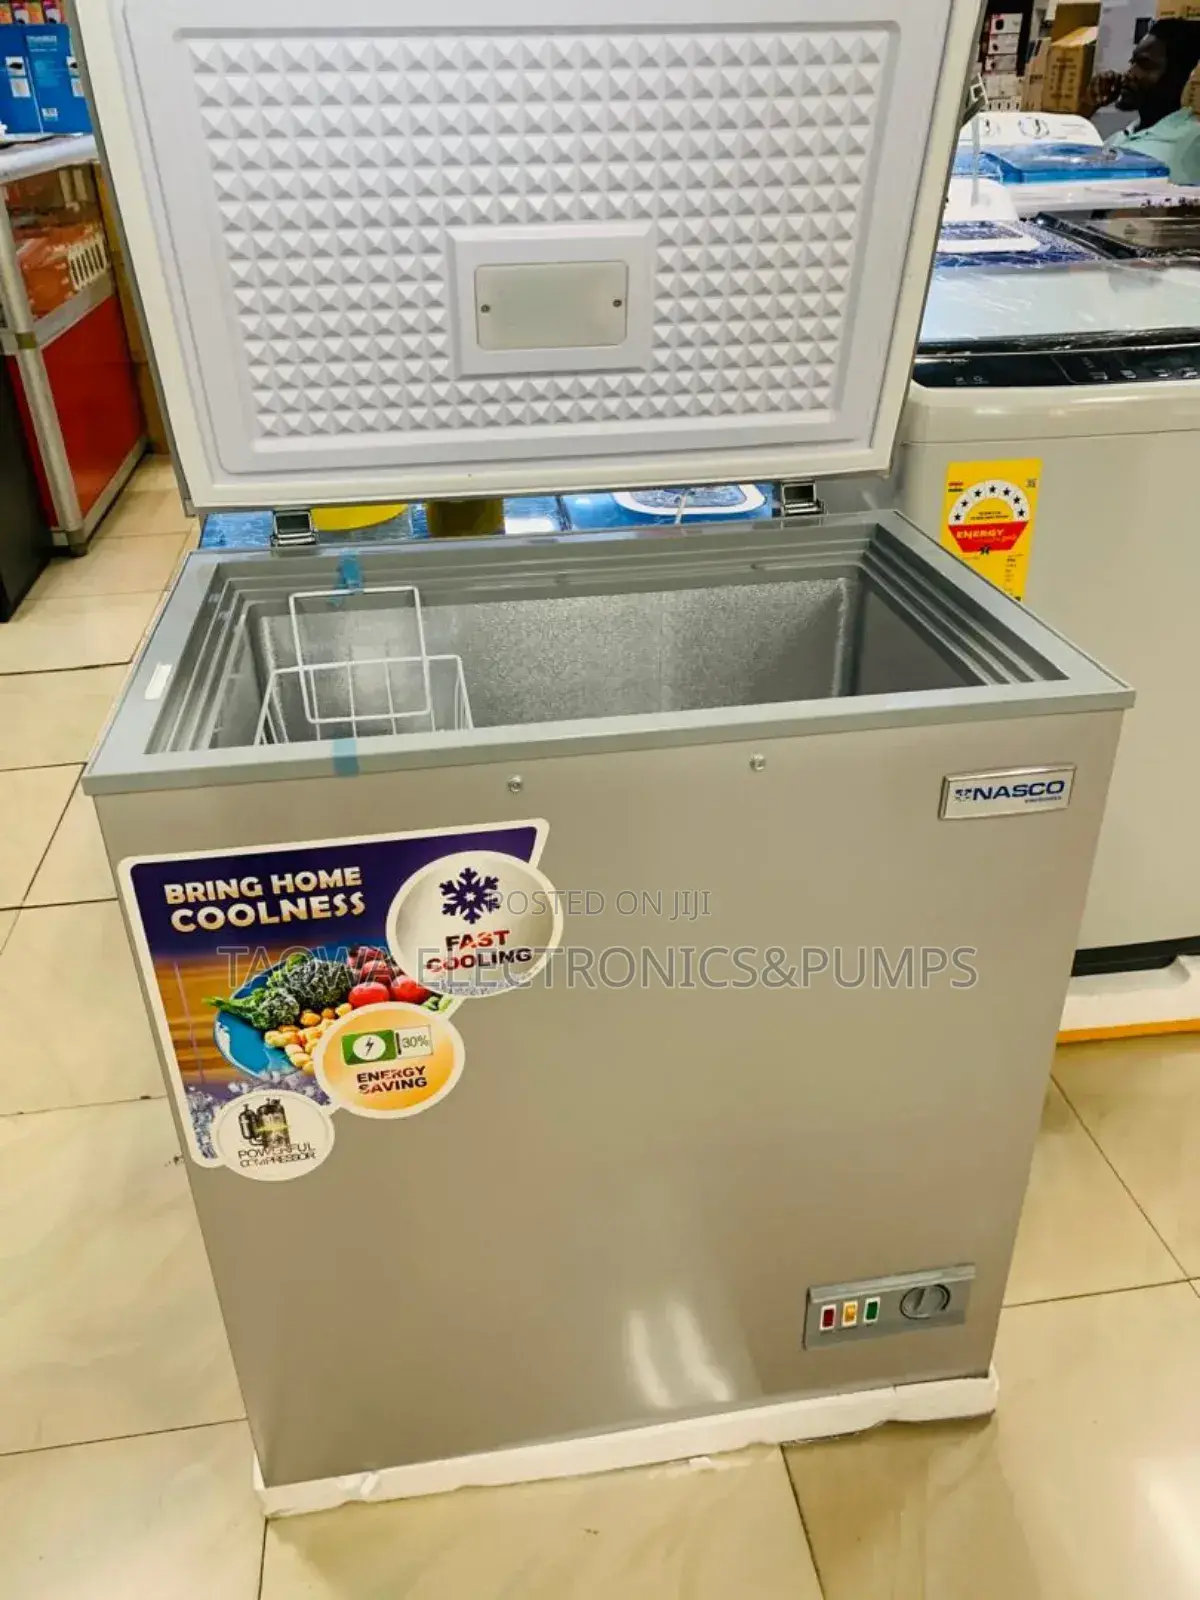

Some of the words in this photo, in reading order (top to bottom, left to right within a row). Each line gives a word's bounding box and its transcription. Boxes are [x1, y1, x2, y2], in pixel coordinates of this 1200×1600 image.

[972, 780, 1065, 801] NASCO
[163, 876, 264, 904] BRING
[270, 866, 363, 894] HOME
[170, 891, 366, 933] COOLNESS
[445, 929, 510, 952] FAST
[425, 947, 533, 973] COOLING
[402, 1035, 429, 1049] 30%
[356, 1065, 427, 1083] ENERGY
[358, 1077, 428, 1095] SAVING
